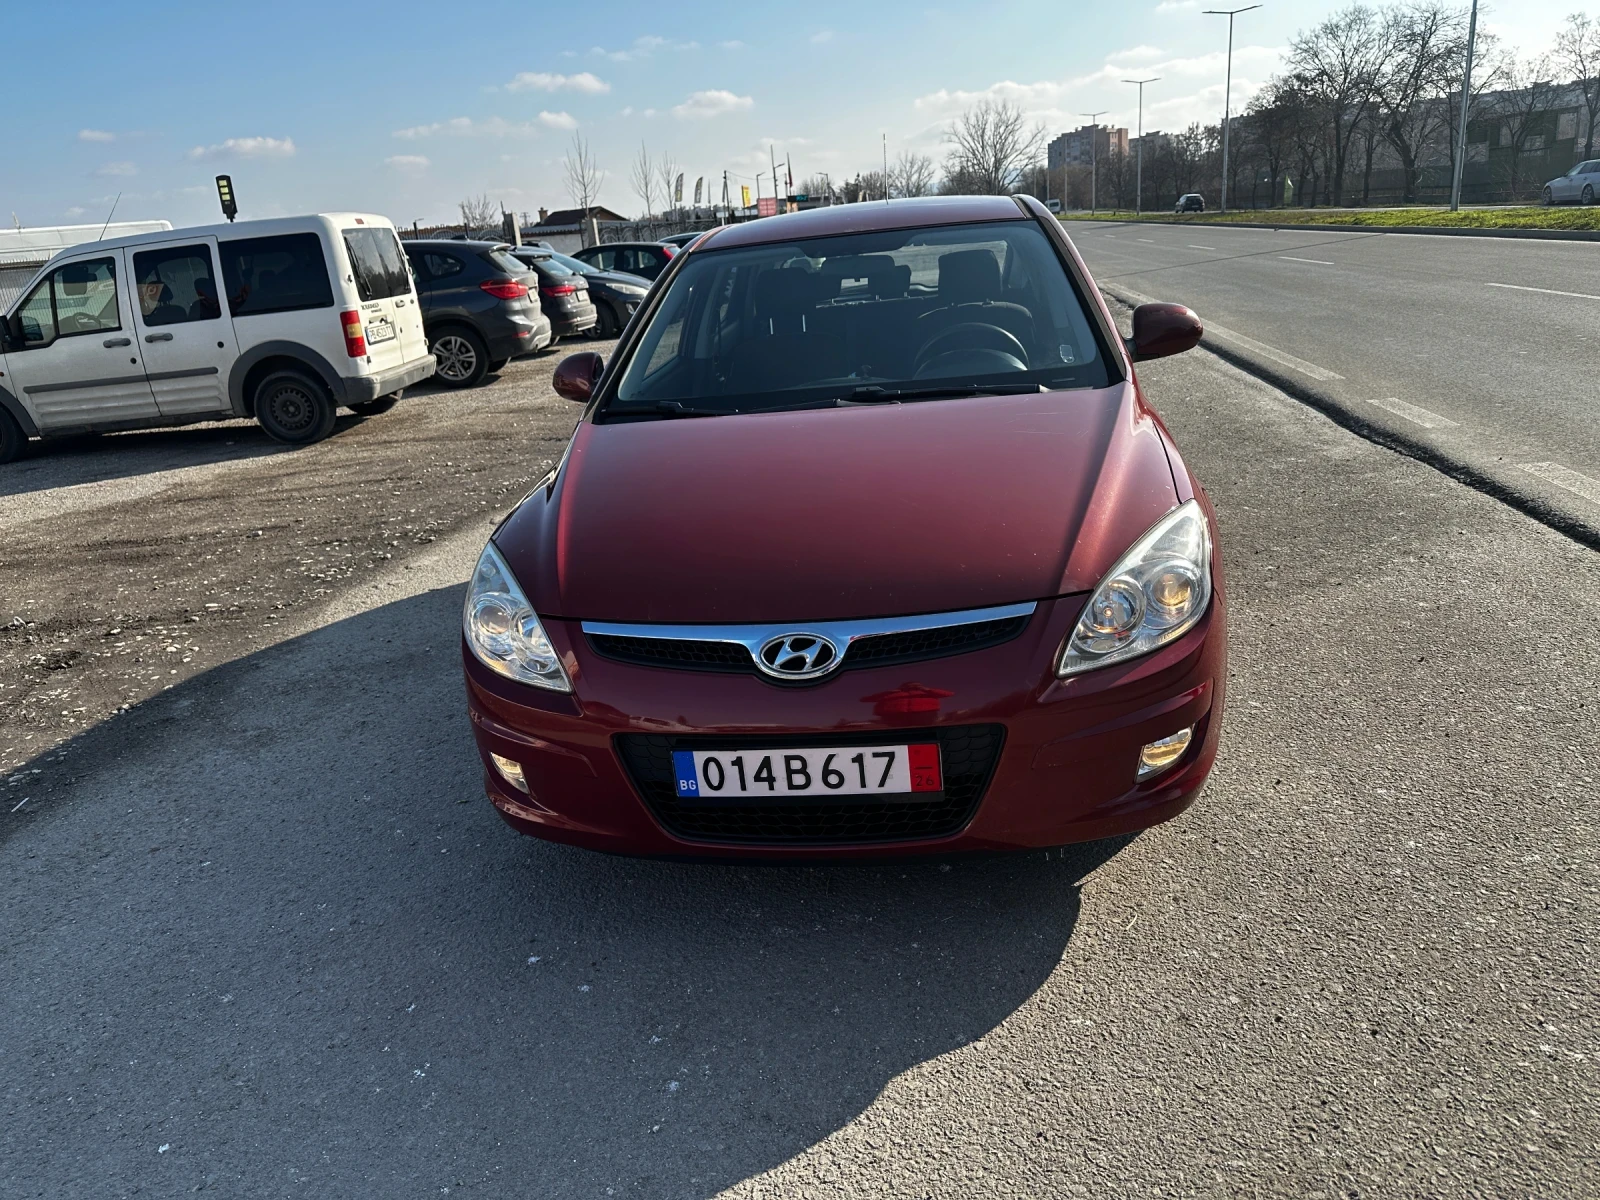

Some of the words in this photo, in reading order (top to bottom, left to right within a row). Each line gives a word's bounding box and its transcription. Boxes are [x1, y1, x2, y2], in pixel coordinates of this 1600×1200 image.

[702, 752, 896, 791] 014B617
[679, 779, 697, 791] BG
[915, 773, 934, 787] 26
